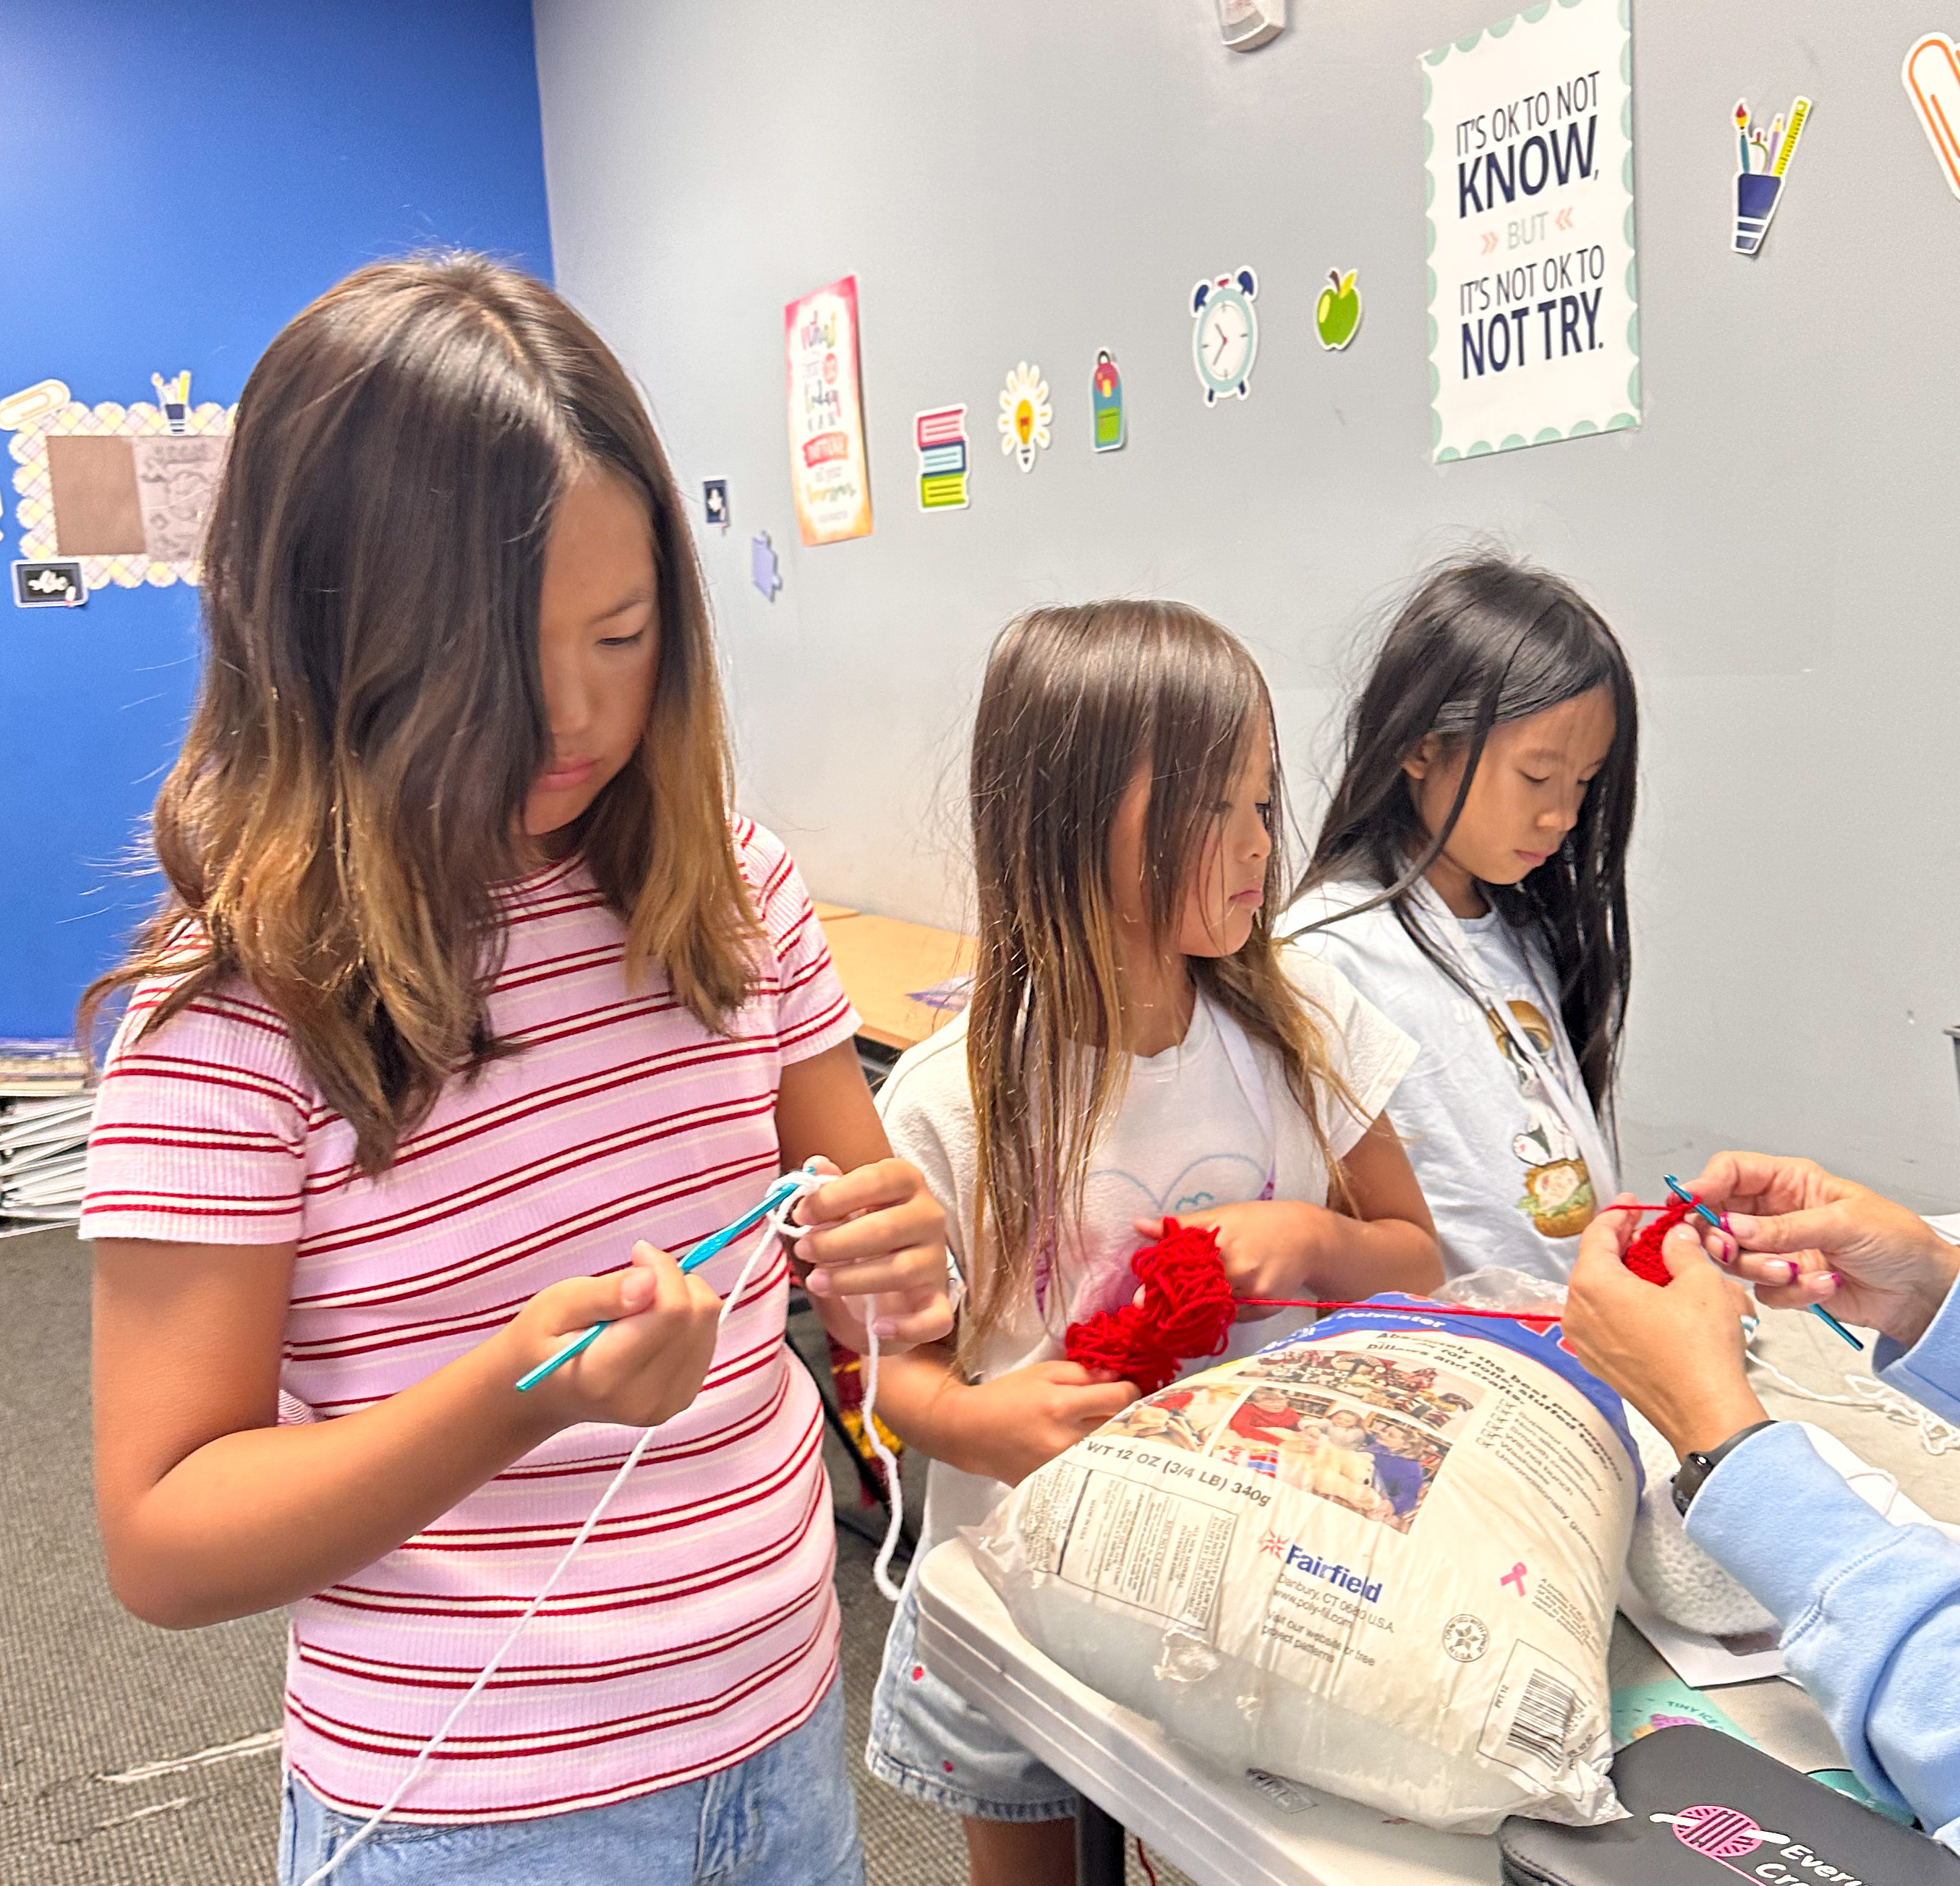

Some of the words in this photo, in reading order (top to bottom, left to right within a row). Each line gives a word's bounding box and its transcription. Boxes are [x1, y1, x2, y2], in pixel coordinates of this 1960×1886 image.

[1456, 115, 1486, 156] IT'S
[1493, 101, 1520, 143] OK
[1523, 91, 1549, 130] TO
[1556, 71, 1600, 120] NOT
[1457, 115, 1598, 218] KNOW,
[1507, 212, 1548, 250] BUT
[1460, 277, 1491, 316] IT'S
[1496, 264, 1538, 305] NOT
[1543, 255, 1572, 291] OK
[1577, 244, 1605, 284] TO
[1462, 307, 1530, 380] NOT
[1538, 287, 1604, 360] TRY.
[1479, 1357, 1505, 1373] the
[1510, 1375, 1548, 1399] best
[1086, 1441, 1115, 1455] WT
[1116, 1449, 1133, 1460] 12
[1137, 1454, 1162, 1467] OZ
[1162, 1460, 1195, 1478] (3/4
[1198, 1471, 1228, 1491] LB)
[1231, 1482, 1271, 1507] 340g
[1286, 1545, 1382, 1603] Fairfield
[1323, 1593, 1339, 1607] CT
[1287, 1621, 1305, 1633] our
